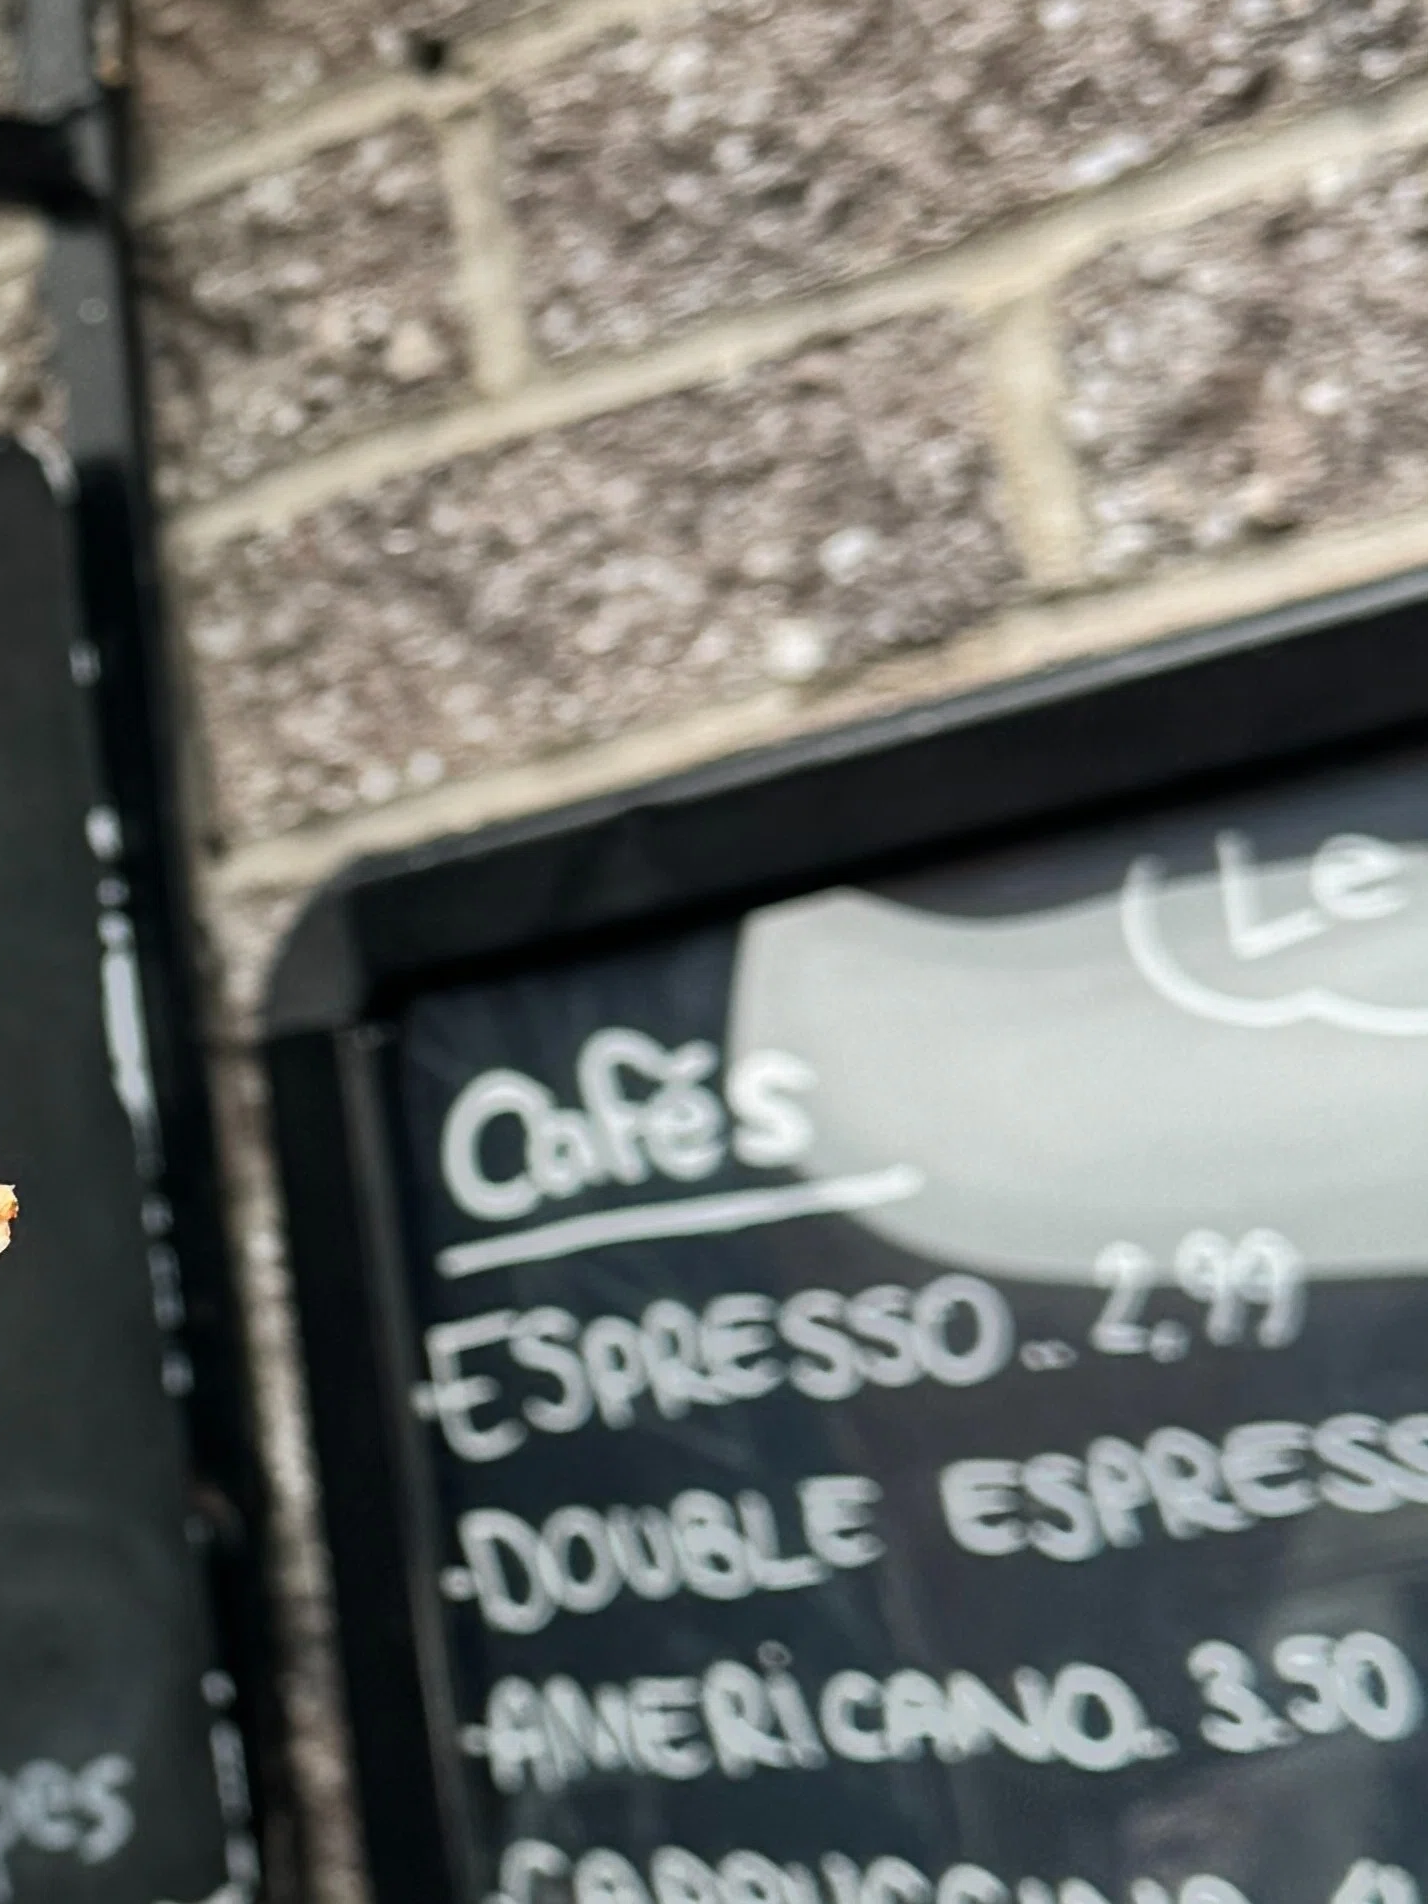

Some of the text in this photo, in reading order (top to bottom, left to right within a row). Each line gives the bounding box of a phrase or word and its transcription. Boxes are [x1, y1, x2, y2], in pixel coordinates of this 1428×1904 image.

[1214, 828, 1408, 960] Le
[441, 1026, 818, 1221] Cafés
[1089, 1227, 1309, 1364] 2.99
[458, 1474, 886, 1634] DOUBLE
[1187, 1630, 1422, 1753] 3.50
